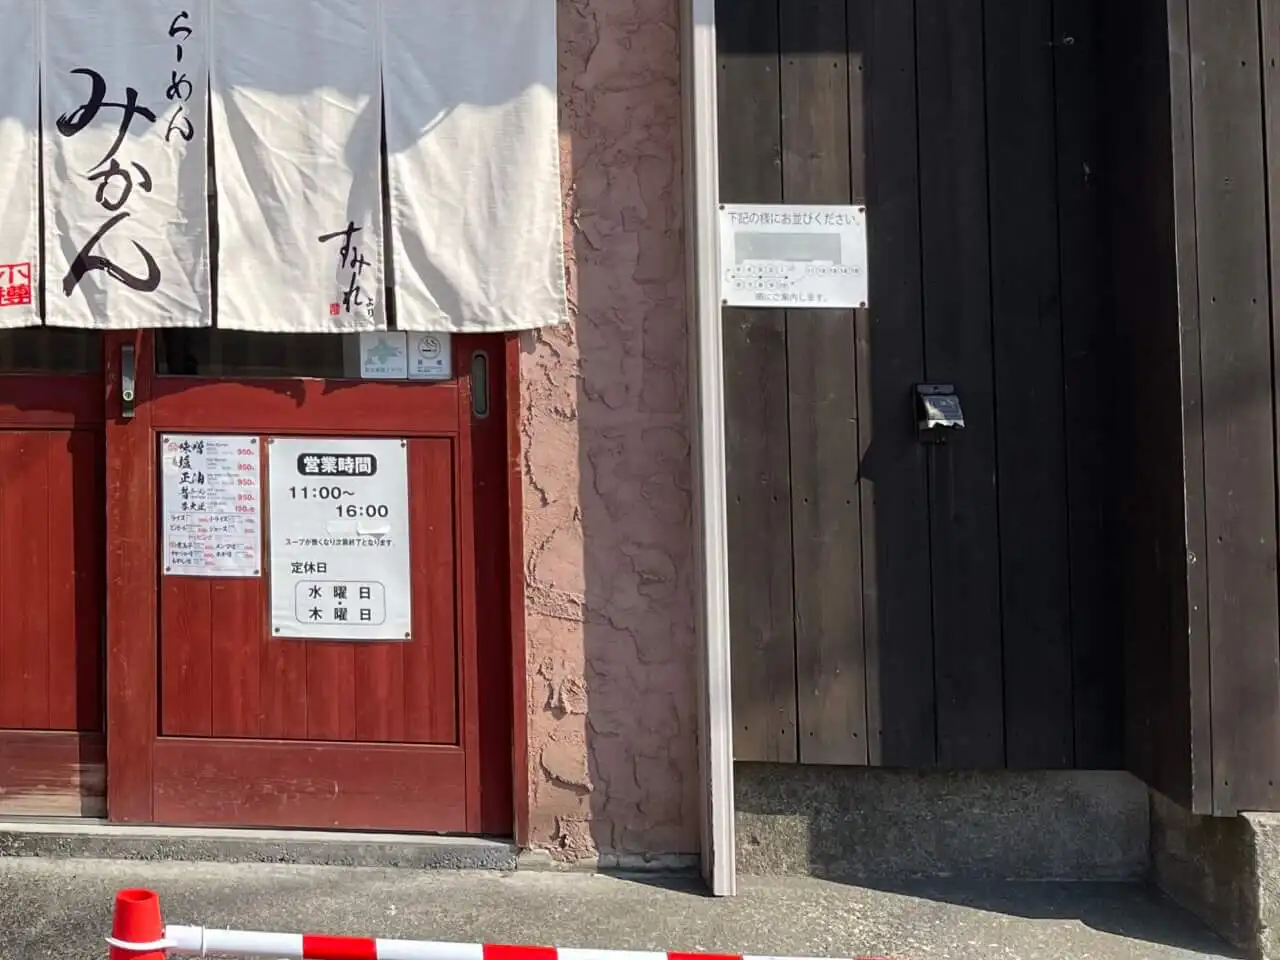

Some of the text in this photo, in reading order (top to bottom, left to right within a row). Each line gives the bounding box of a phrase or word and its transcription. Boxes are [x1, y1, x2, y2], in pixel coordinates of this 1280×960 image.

[165, 11, 194, 142] らーめん
[56, 68, 161, 297] みかん
[303, 456, 373, 475] 営業時間
[336, 504, 389, 518] 16:00
[291, 562, 328, 574] 定休日
